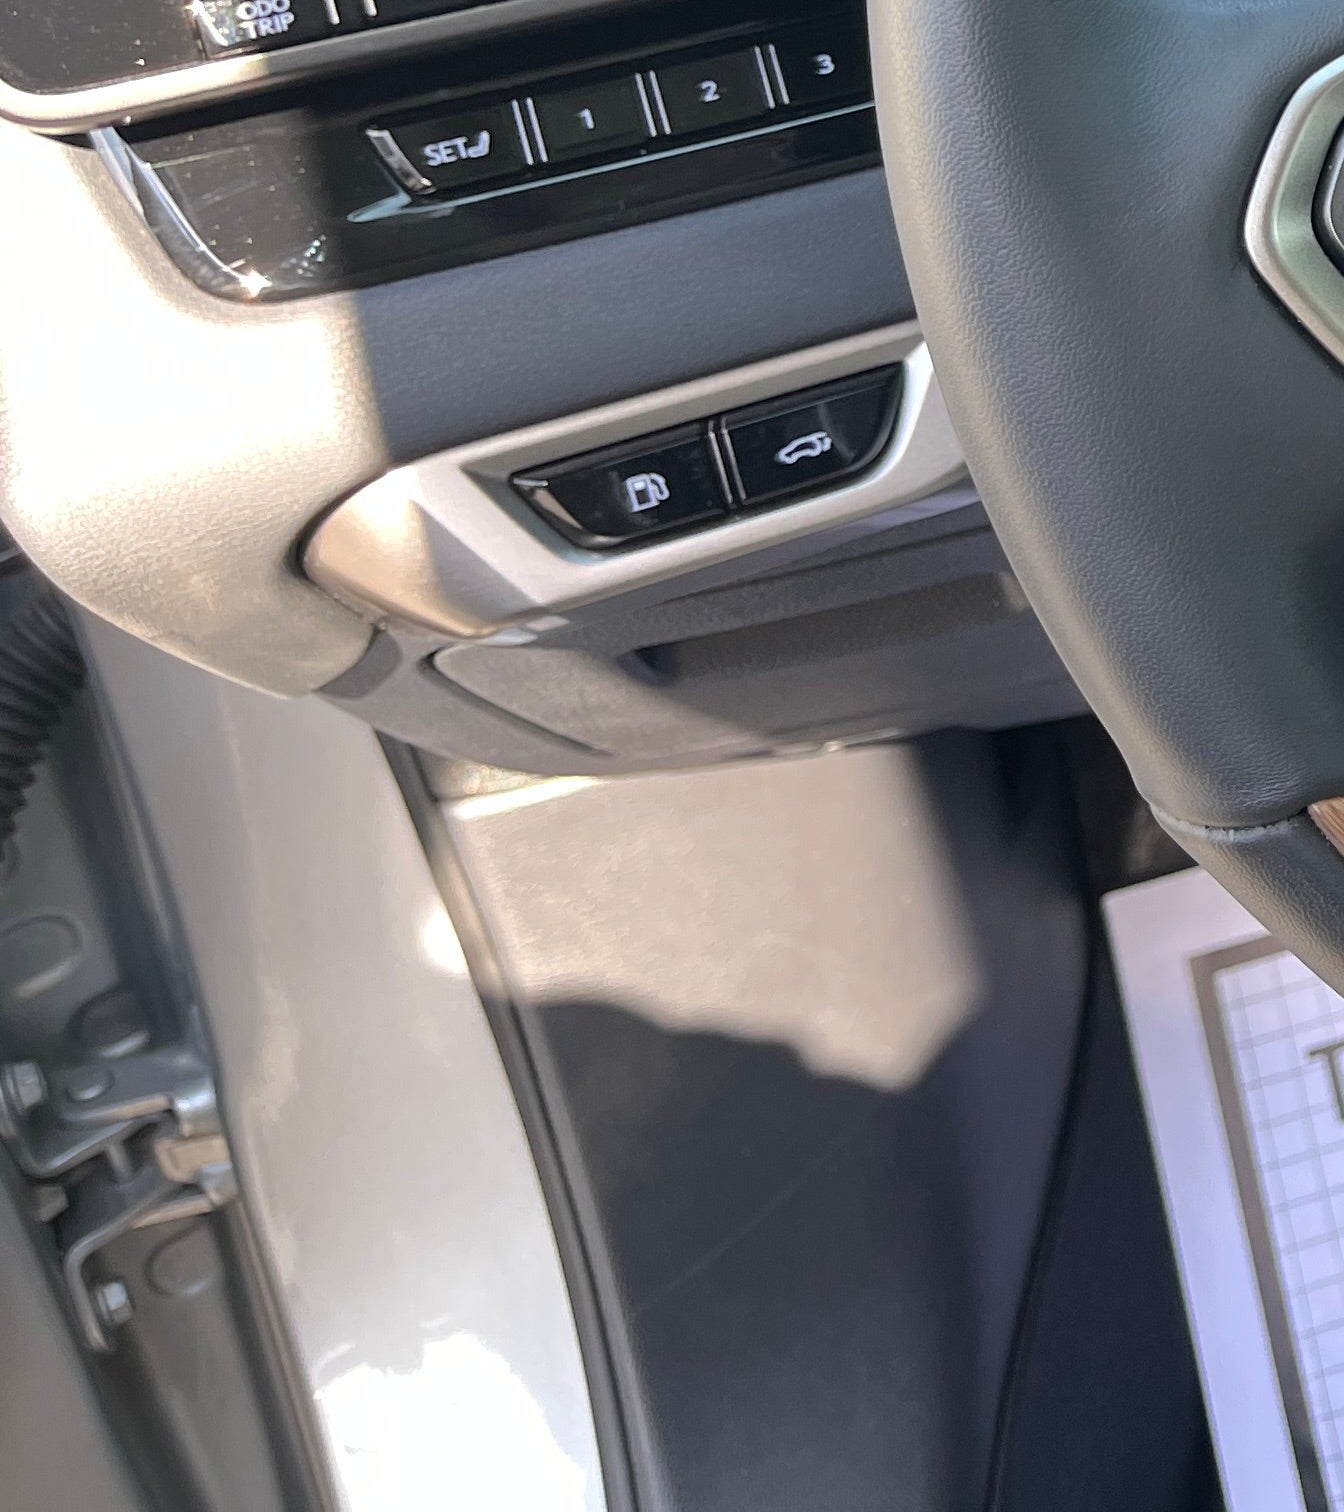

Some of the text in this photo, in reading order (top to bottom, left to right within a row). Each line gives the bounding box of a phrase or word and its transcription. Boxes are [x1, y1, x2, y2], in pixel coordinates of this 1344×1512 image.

[239, 11, 295, 39] TRIP
[814, 53, 836, 76] 3
[700, 79, 721, 104] 2
[579, 108, 596, 130] 1
[423, 136, 467, 167] SET
